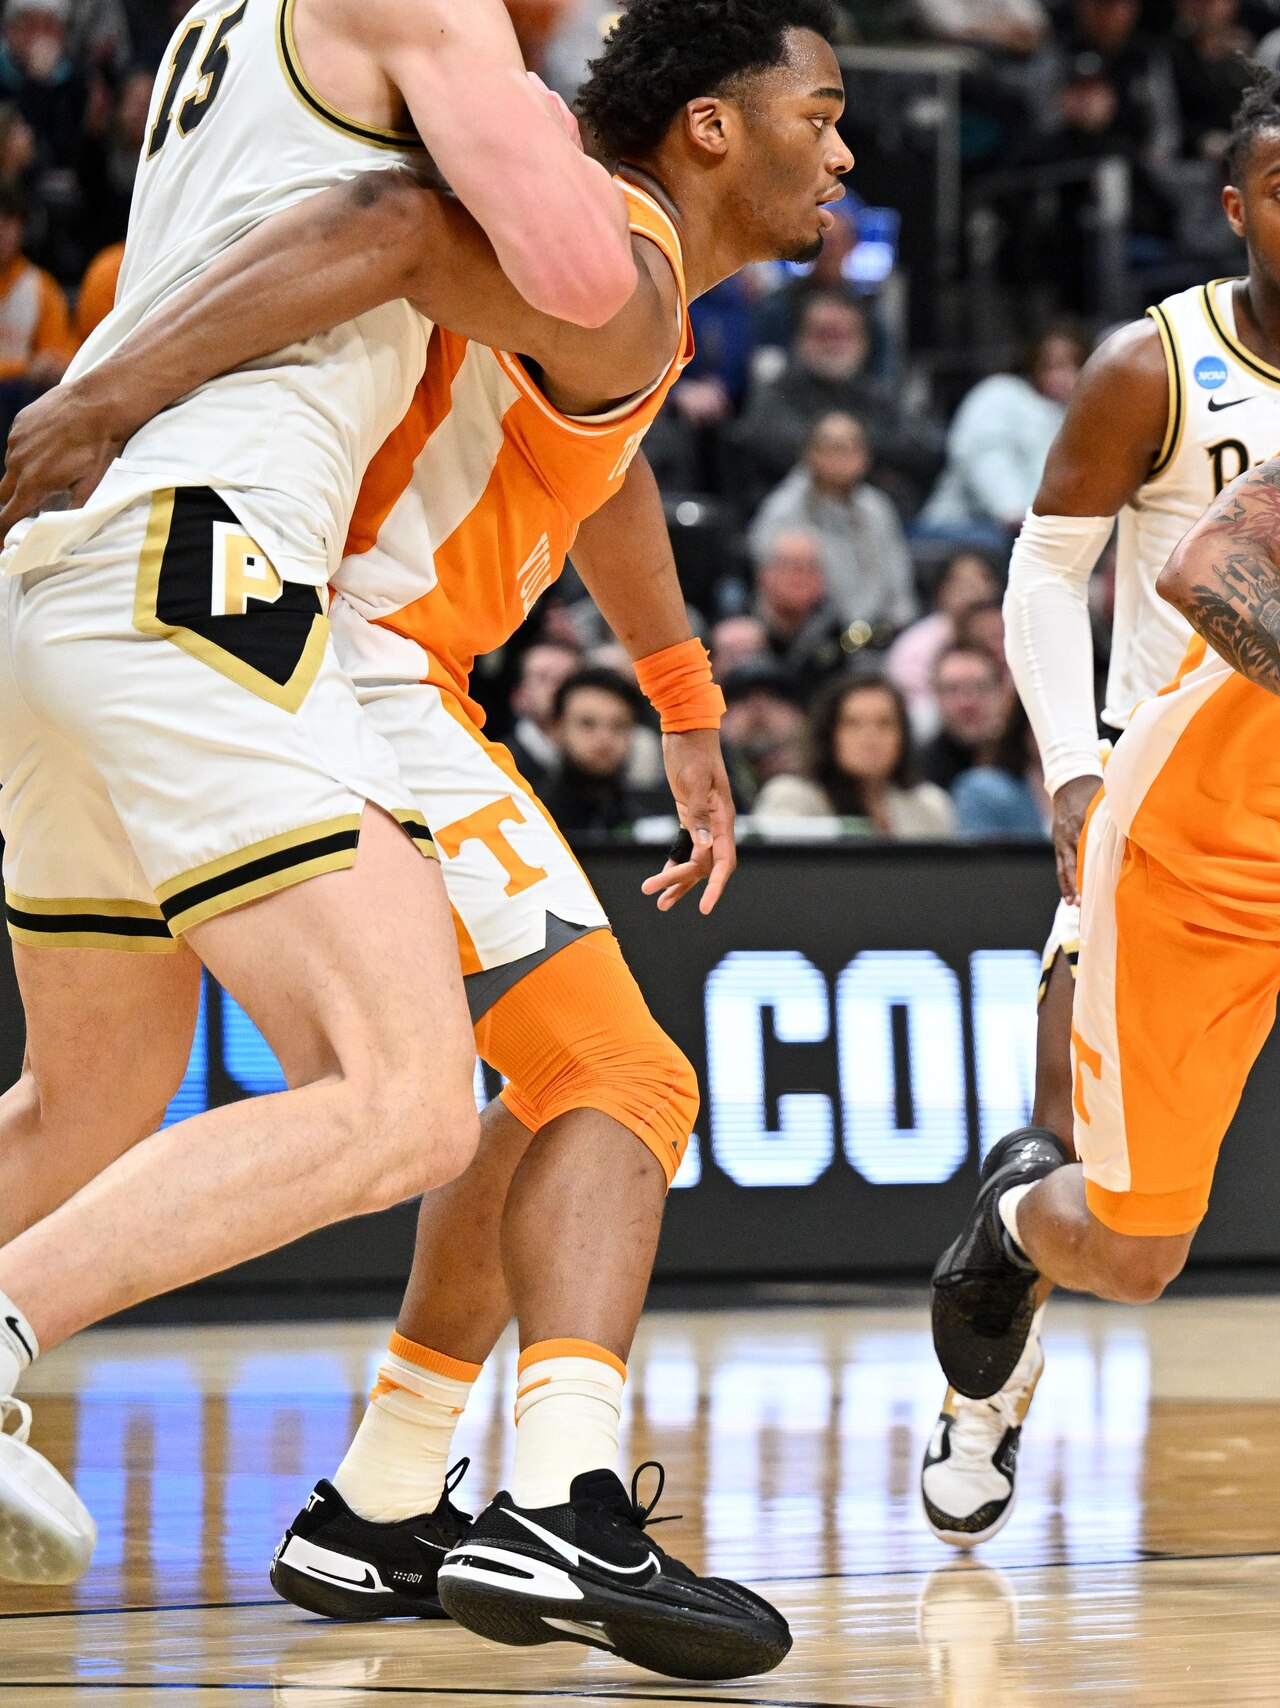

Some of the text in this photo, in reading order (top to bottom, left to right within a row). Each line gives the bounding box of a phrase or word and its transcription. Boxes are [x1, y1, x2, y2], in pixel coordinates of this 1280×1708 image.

[146, 0, 248, 162] 15
[1198, 370, 1226, 382] NCAA
[433, 794, 548, 898] T
